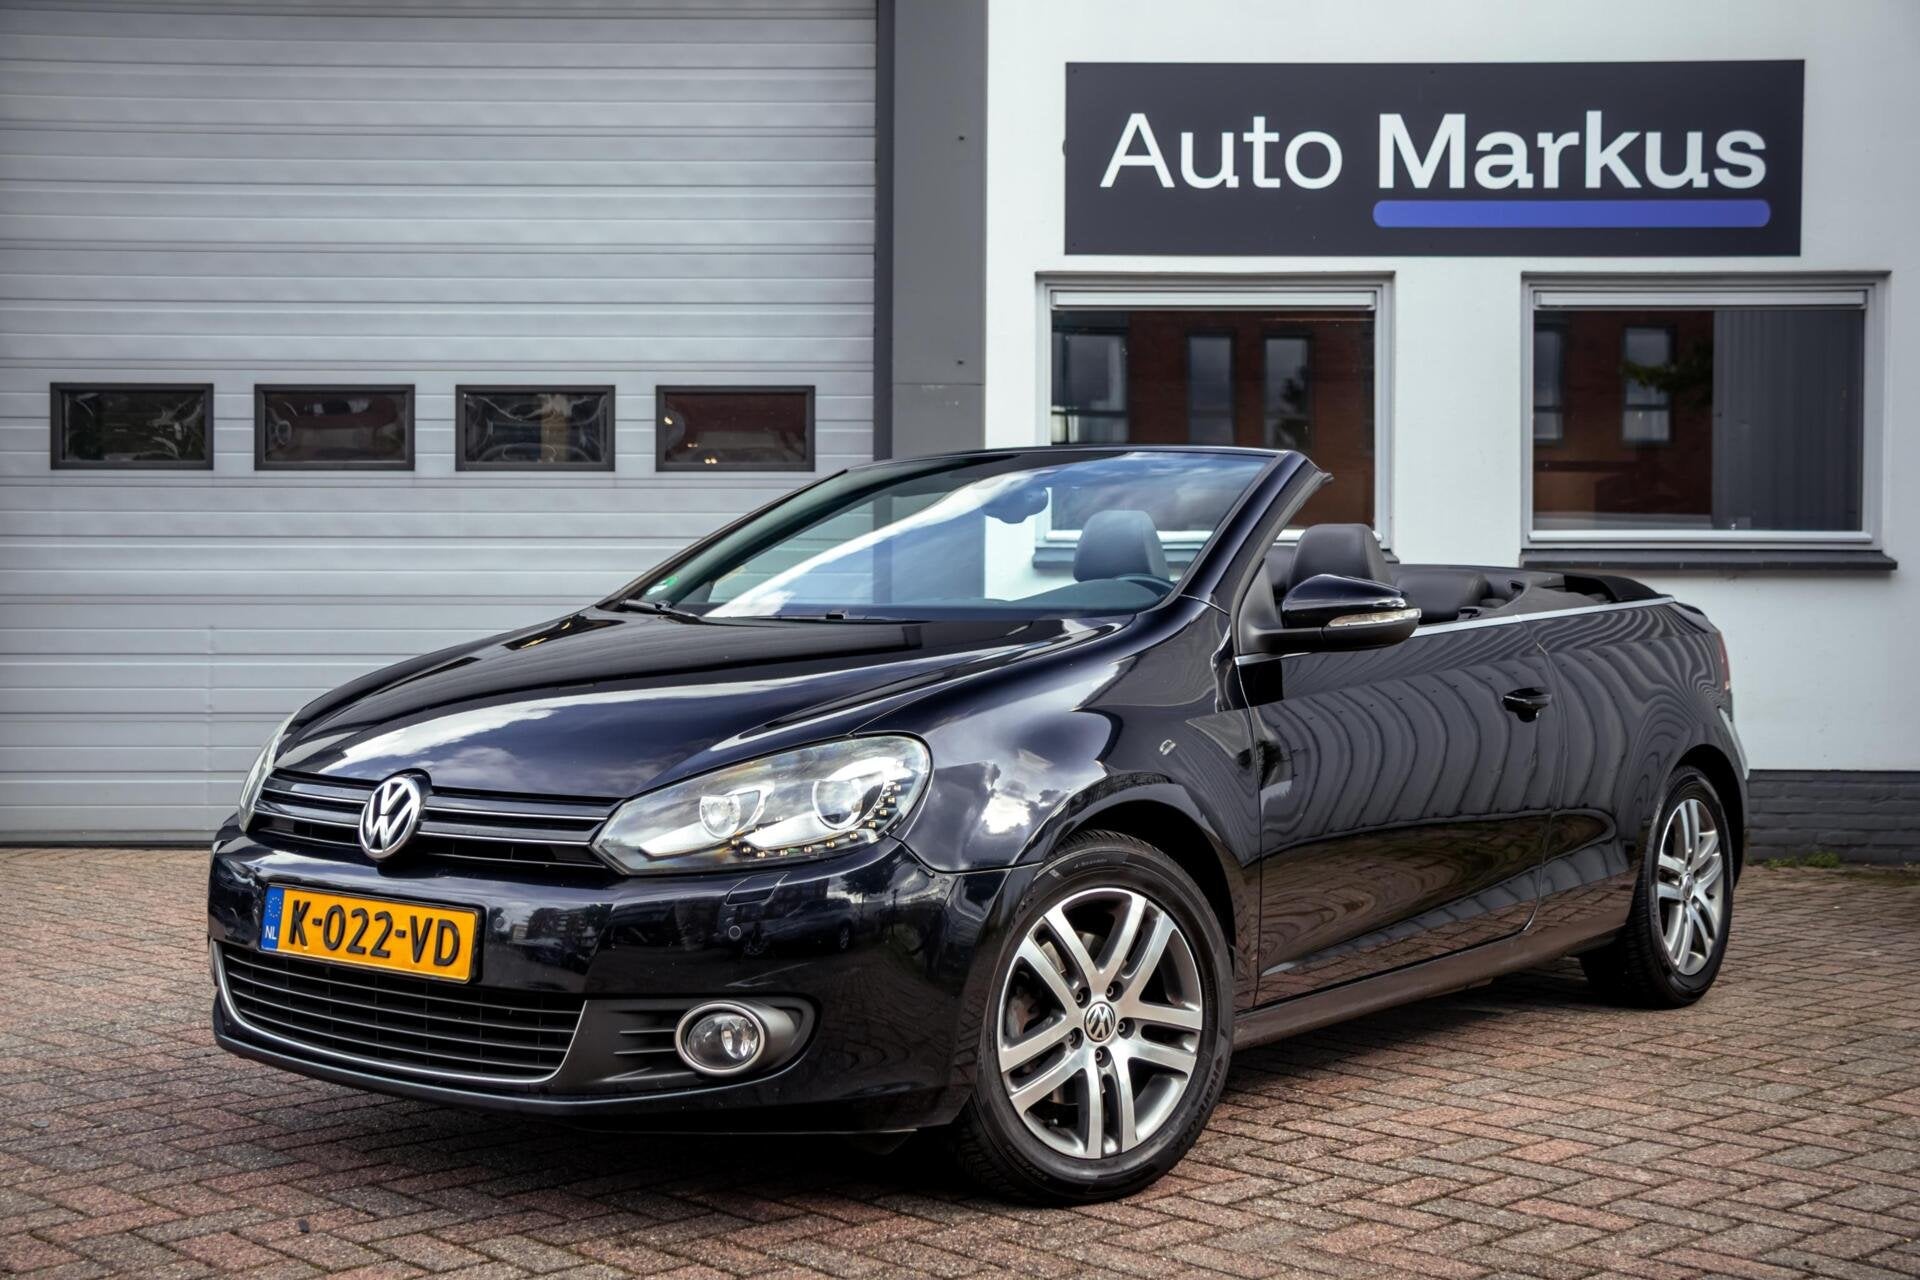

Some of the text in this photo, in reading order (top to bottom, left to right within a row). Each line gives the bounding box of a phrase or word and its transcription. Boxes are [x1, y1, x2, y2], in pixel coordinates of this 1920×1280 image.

[1100, 110, 1767, 190] Auto Markus
[360, 777, 420, 858] VW
[264, 925, 277, 940] NL
[288, 900, 460, 967] K-022-VD
